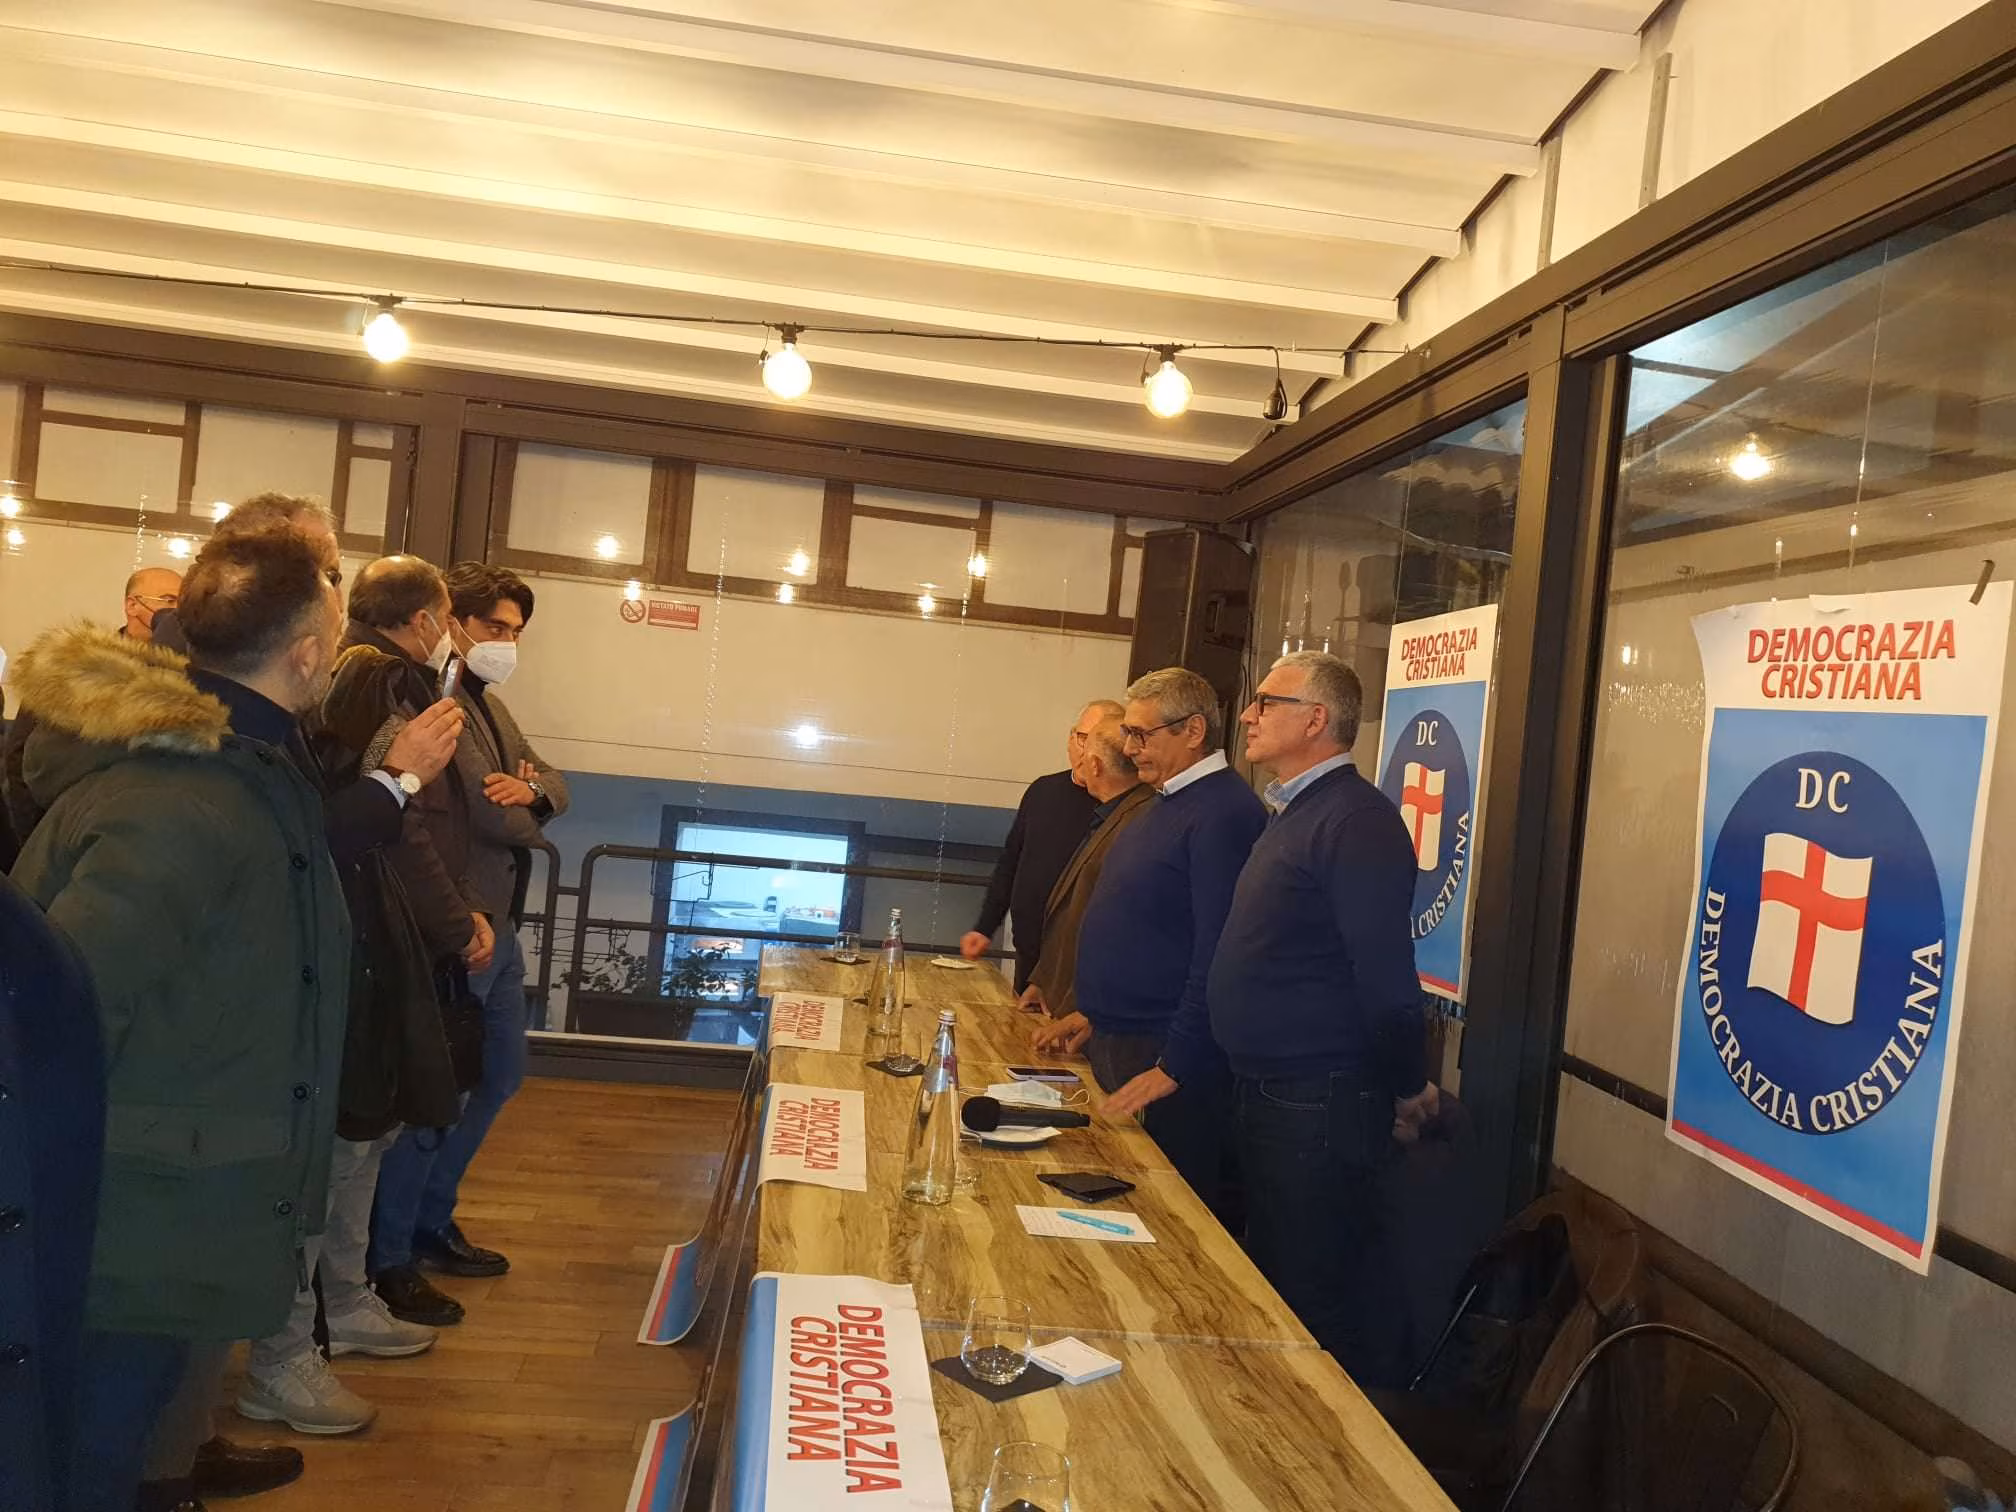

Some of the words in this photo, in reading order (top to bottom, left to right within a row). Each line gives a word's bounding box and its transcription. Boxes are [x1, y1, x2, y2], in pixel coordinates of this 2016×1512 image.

[1401, 627, 1477, 661] DEMOCRAZIA
[1747, 619, 1956, 663] DEMOCRAZIA
[1405, 654, 1465, 681] CRISTIANA
[1761, 662, 1922, 700] CRISTIANA
[1417, 720, 1439, 746] DC
[1795, 767, 1851, 813] DC
[1419, 809, 1470, 937] CRISTIANA
[795, 1000, 826, 1040] DEMOCRAZIA
[1699, 887, 1803, 1131] DEMOCRAZIA
[1809, 938, 1943, 1134] CRISTIANA
[770, 1099, 809, 1156] CRISTIANA
[804, 1098, 841, 1170] DEMOCRAZIA
[787, 1316, 842, 1461] CRISTIANA
[837, 1304, 902, 1493] DEMOCRAZIA
